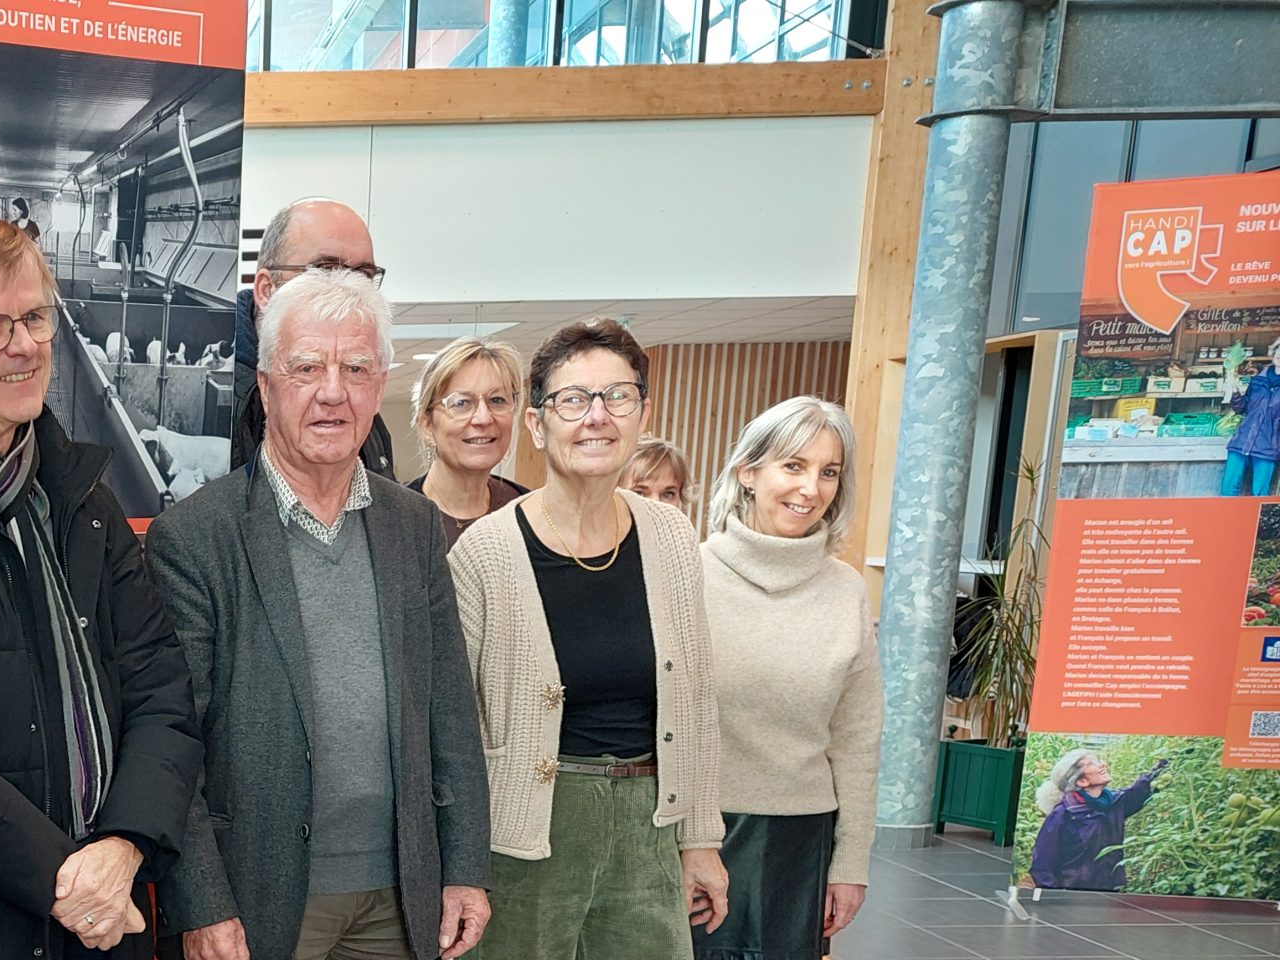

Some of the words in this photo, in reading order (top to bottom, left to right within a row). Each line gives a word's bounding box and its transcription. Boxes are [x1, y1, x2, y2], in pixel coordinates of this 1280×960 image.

[60, 18, 80, 35] ET
[84, 20, 103, 38] DE
[1130, 216, 1194, 231] HANDI
[1236, 220, 1266, 233] SUR
[1126, 229, 1192, 257] CAP
[1231, 263, 1245, 272] LE
[1246, 261, 1271, 271] RÊVE
[1229, 274, 1269, 284] DEVENU
[1089, 317, 1125, 336] Petit
